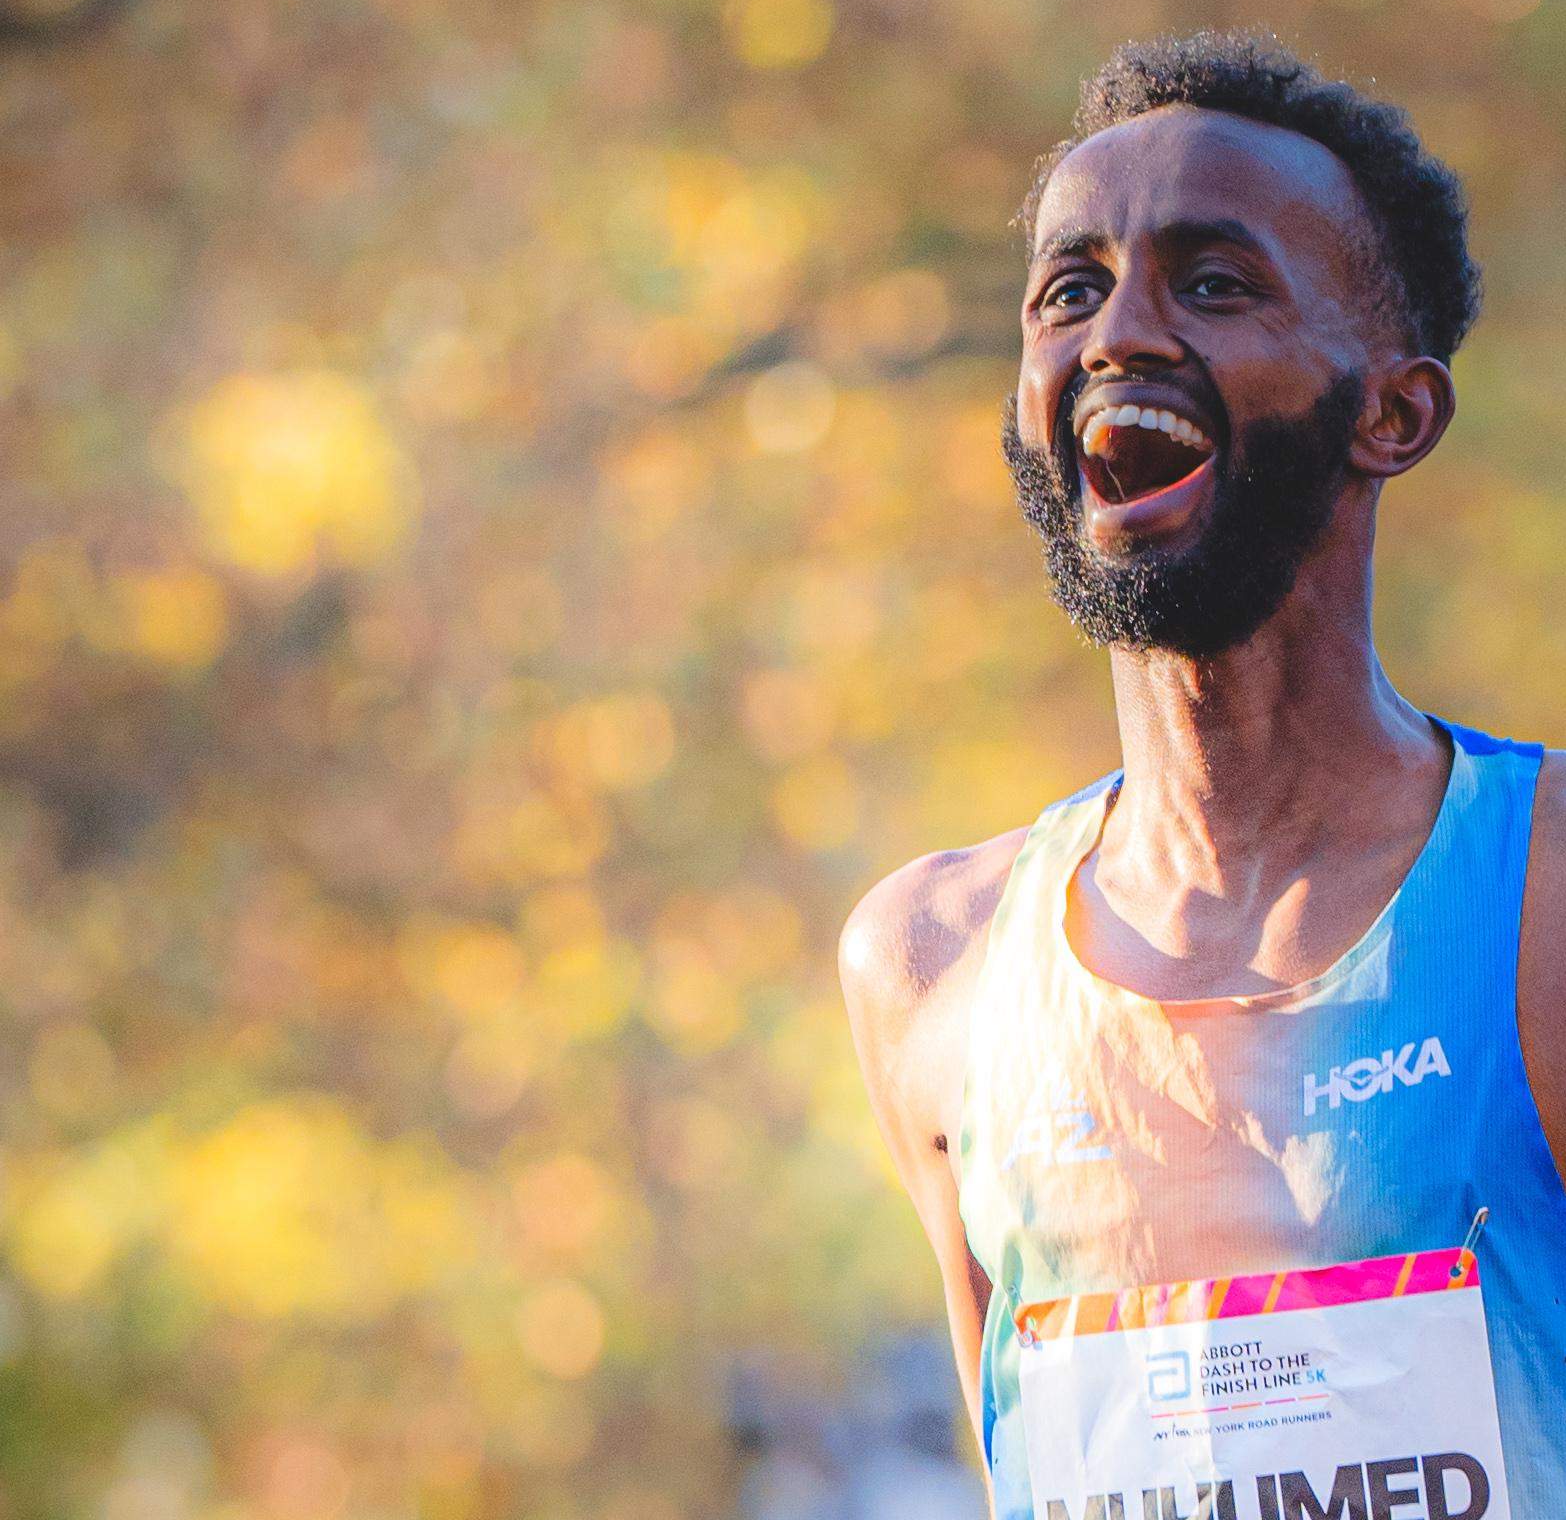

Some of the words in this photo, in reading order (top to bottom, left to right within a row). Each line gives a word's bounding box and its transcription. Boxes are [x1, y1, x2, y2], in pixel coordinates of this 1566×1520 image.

[1304, 1036, 1452, 1116] HOKA
[1201, 1341, 1262, 1361] ABBOTT
[1201, 1361, 1245, 1379] DASH
[1252, 1360, 1272, 1372] TO
[1278, 1353, 1310, 1368] THE
[1202, 1376, 1258, 1397] FINISH
[1264, 1371, 1302, 1388] LINE
[1306, 1369, 1327, 1383] 5K
[1215, 1423, 1245, 1434] YORK
[1248, 1419, 1279, 1429] ROAD
[1281, 1411, 1333, 1425] RUNNERS
